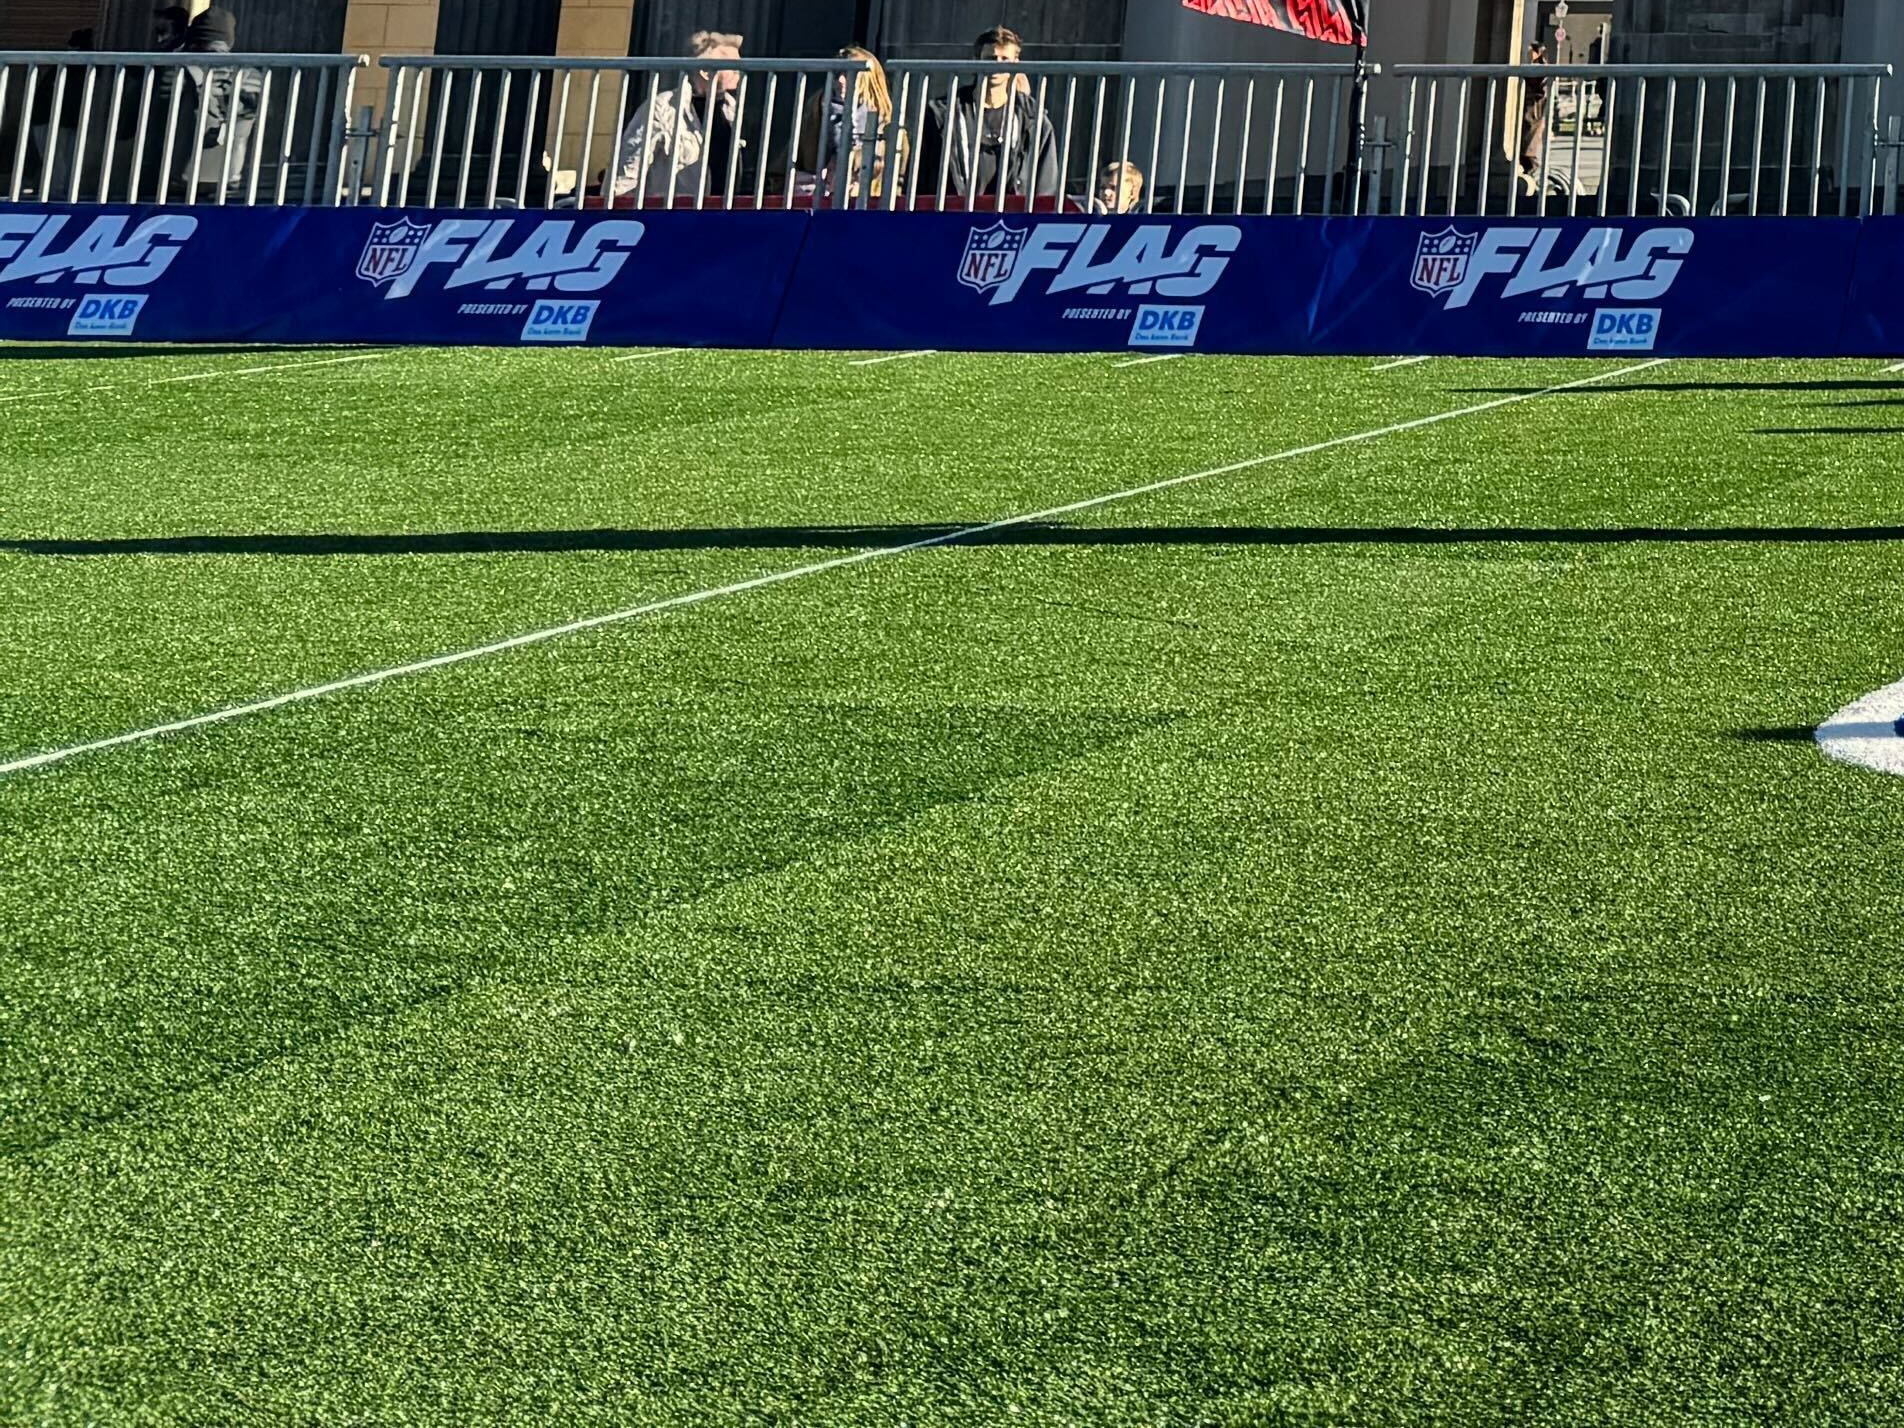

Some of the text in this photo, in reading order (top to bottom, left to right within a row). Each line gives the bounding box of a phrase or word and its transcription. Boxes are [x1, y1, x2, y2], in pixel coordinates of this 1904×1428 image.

[366, 219, 645, 300] NFL FLAG
[966, 223, 1242, 306] NFL FLAG
[1419, 227, 1695, 310] NFL FLAG
[78, 299, 139, 320] DKB
[532, 305, 591, 325] DKB
[1139, 311, 1195, 331] DKB
[1596, 313, 1654, 335] DKB
